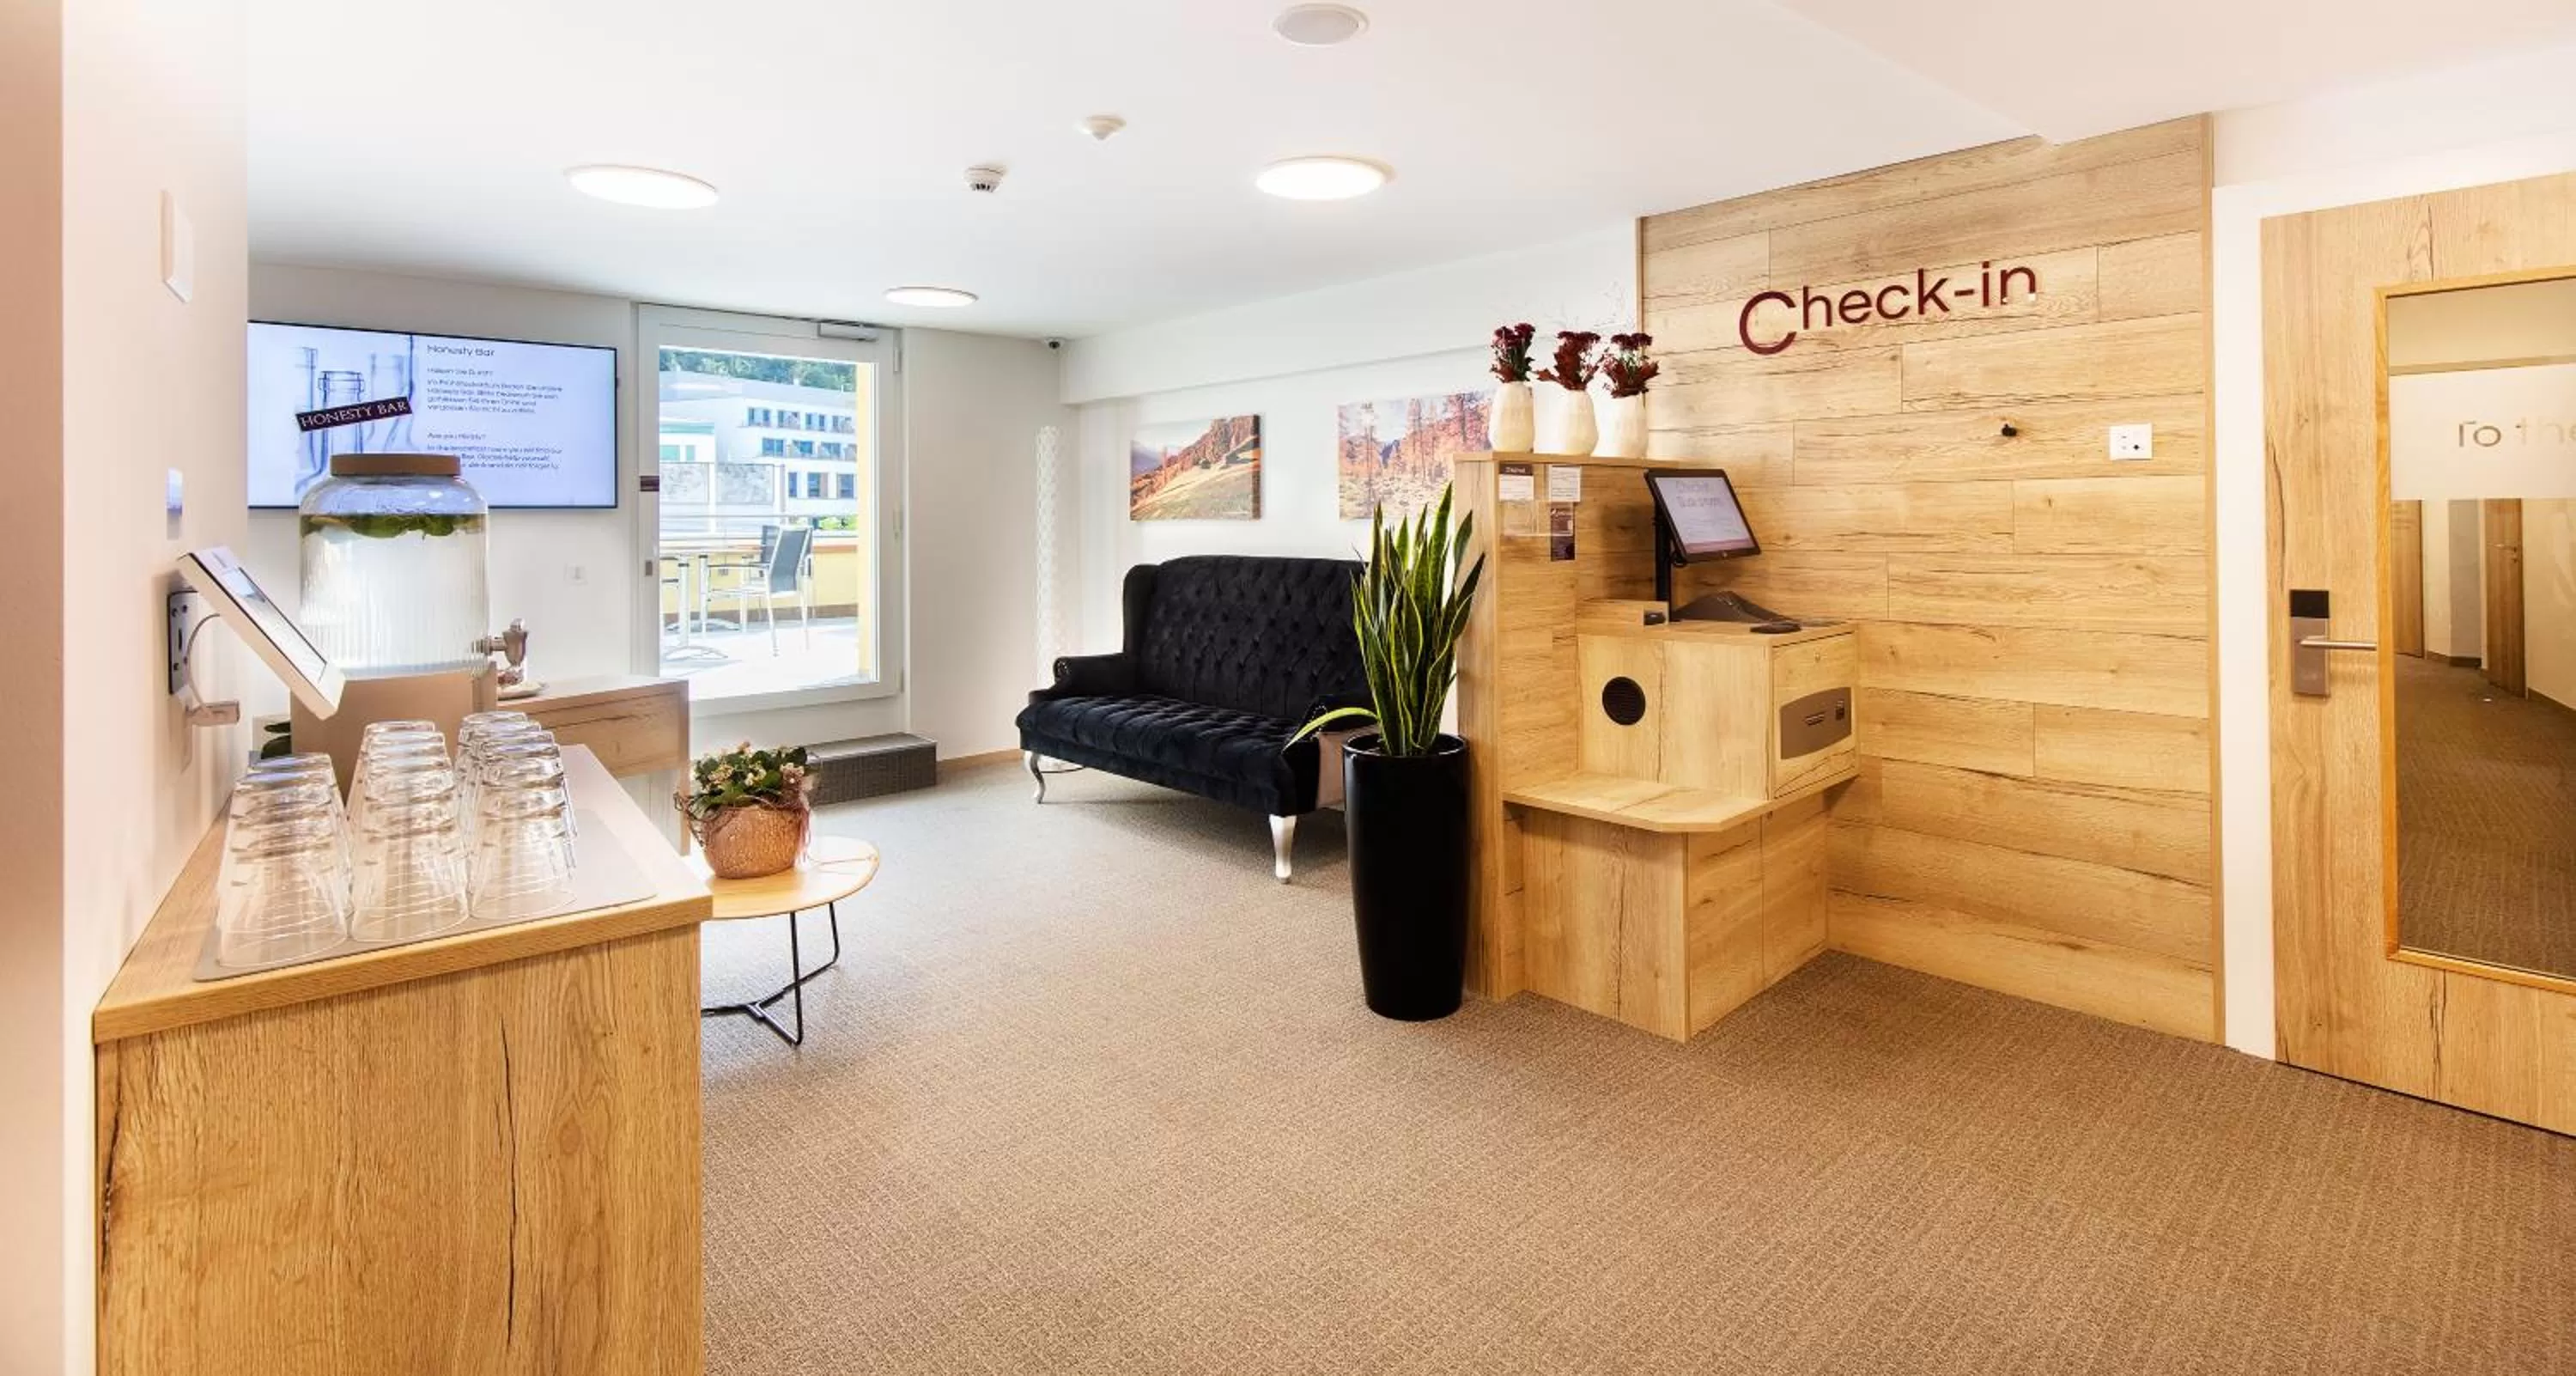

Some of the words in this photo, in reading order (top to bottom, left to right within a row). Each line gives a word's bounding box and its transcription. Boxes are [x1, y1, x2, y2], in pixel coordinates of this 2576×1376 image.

[1739, 260, 2037, 356] Check-in
[475, 348, 495, 356] Bar
[300, 406, 373, 427] HONESTY
[378, 401, 406, 415] BAR
[2458, 420, 2501, 448] To
